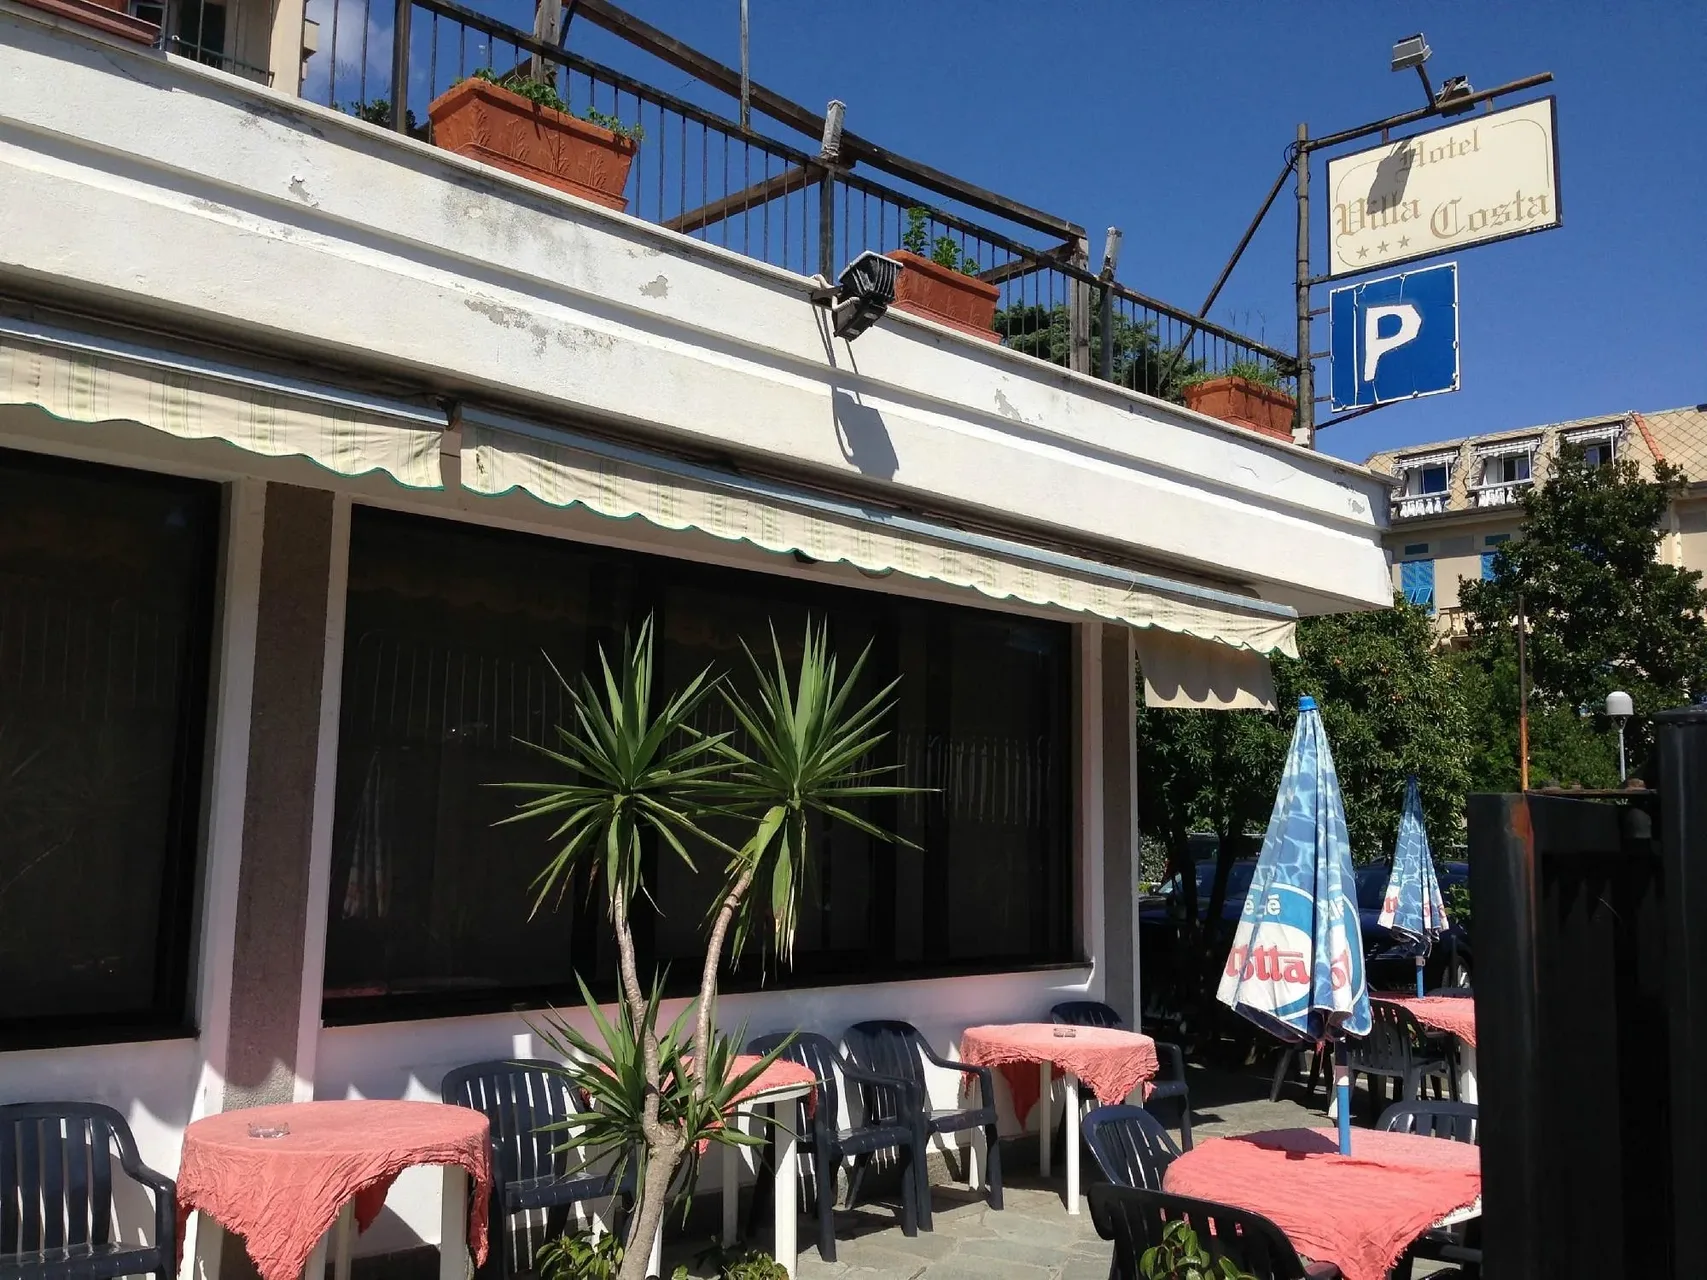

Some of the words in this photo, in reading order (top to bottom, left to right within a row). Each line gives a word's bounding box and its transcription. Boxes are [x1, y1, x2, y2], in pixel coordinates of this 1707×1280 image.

[1396, 126, 1482, 181] Hotel
[1333, 190, 1422, 247] Villa
[1430, 189, 1550, 239] Costa
[1363, 303, 1423, 383] P
